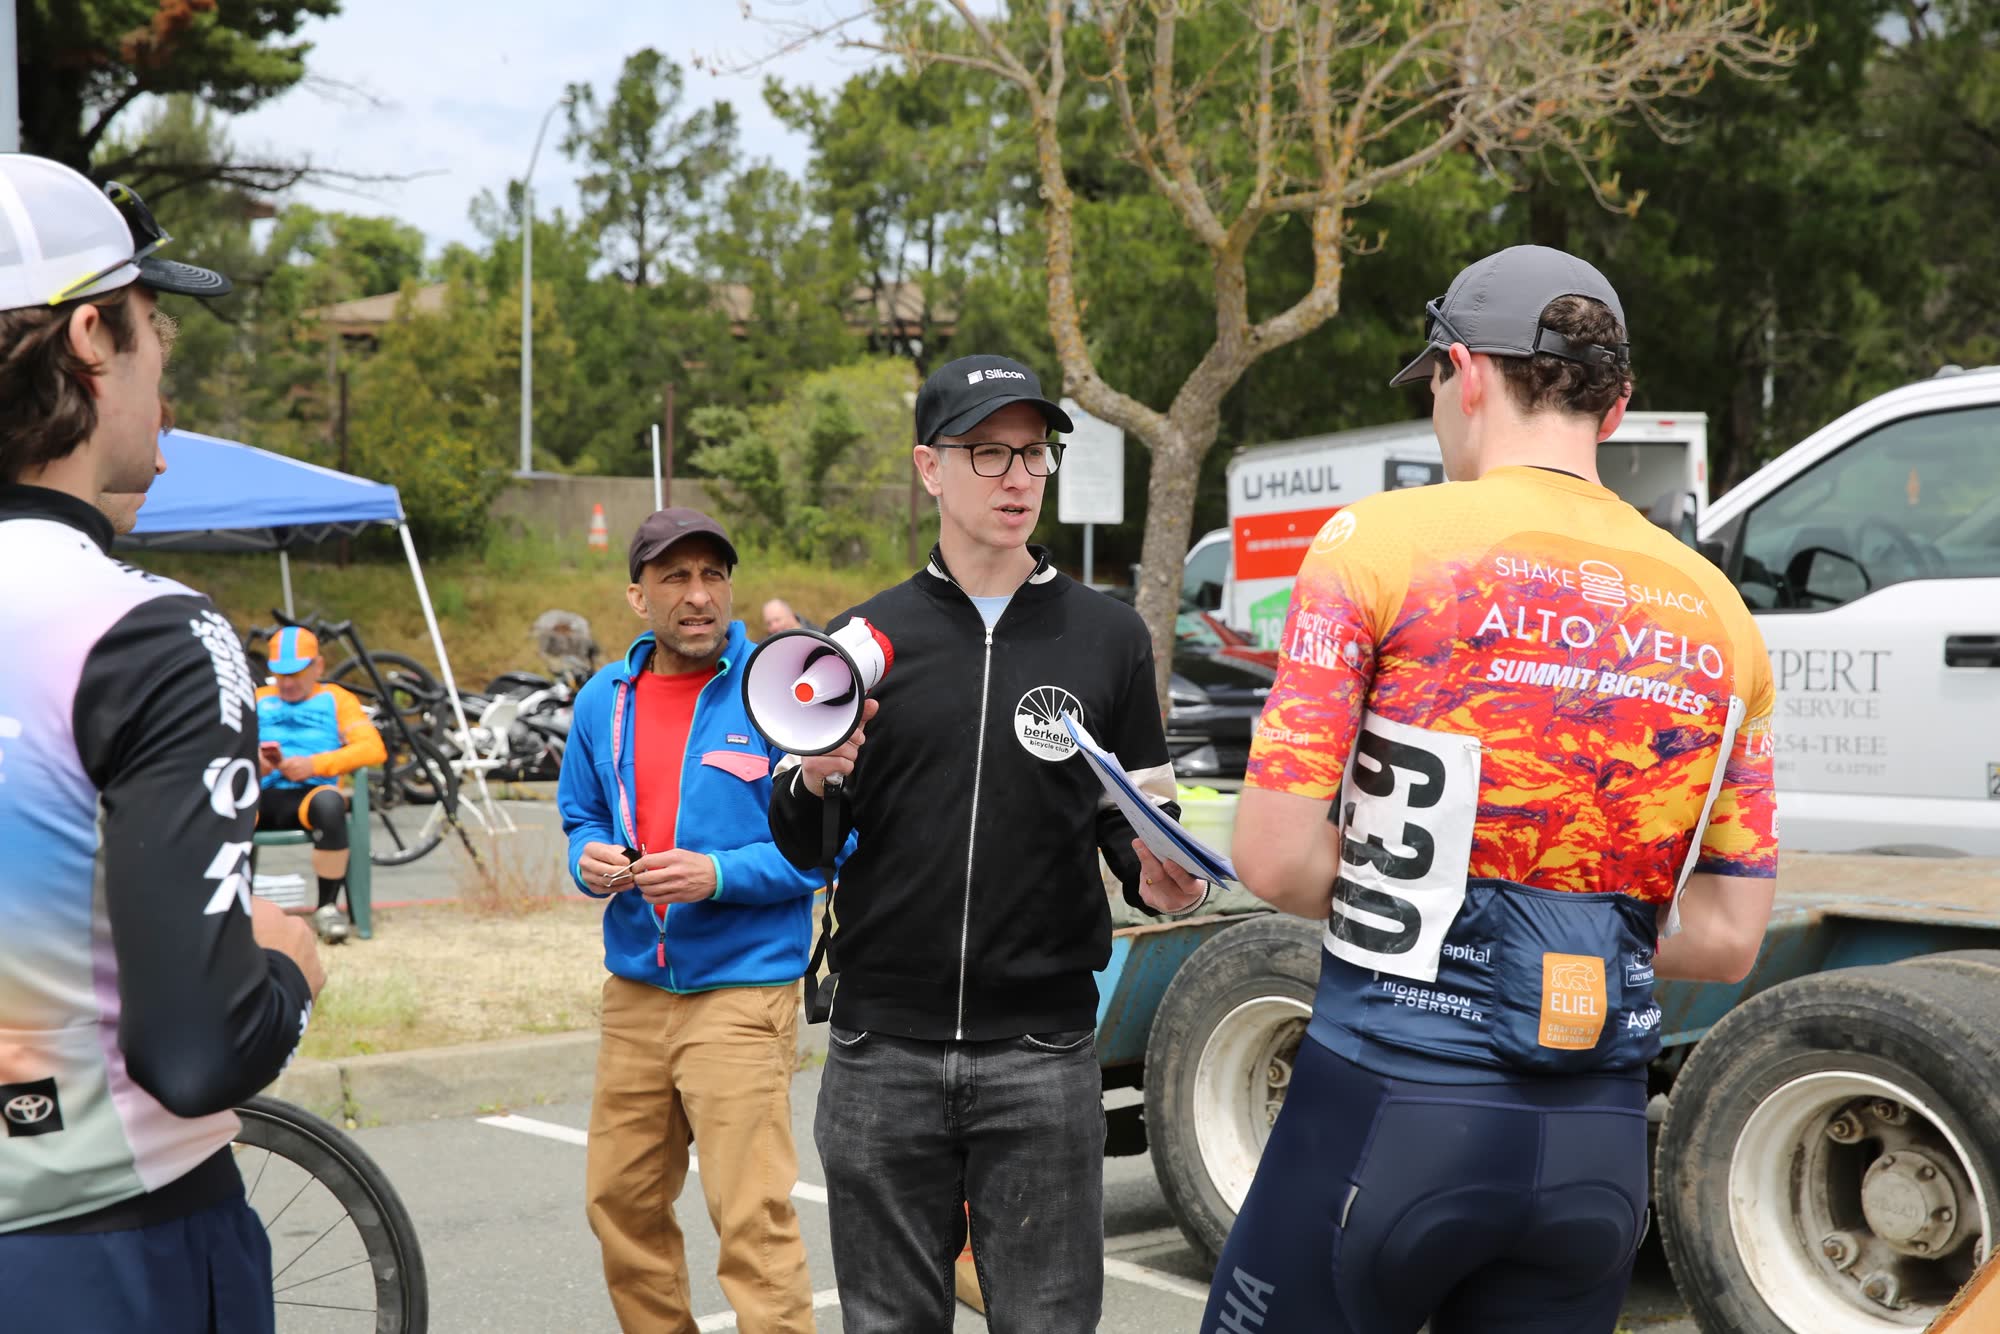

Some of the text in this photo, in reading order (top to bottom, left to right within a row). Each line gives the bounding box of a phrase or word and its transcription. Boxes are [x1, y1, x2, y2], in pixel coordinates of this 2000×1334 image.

[985, 368, 1026, 380] Silicon
[1243, 465, 1342, 500] U-HAUL
[1495, 556, 1708, 618] SHAKE SHACK
[1296, 609, 1345, 640] BICYCLE
[1290, 628, 1340, 670] LAW
[1476, 602, 1724, 680] ALTO VELO
[1767, 648, 1892, 693] PERT
[1486, 658, 1709, 716] SUMMIT BICYCLES
[1784, 698, 1881, 720] SERVICE
[1024, 725, 1076, 748] berkeley
[1030, 740, 1069, 754] bicycle club
[1328, 728, 1446, 955] 630
[1441, 943, 1491, 964] apital
[1394, 994, 1483, 1022] FOERSTER
[1550, 991, 1599, 1016] ELIEL
